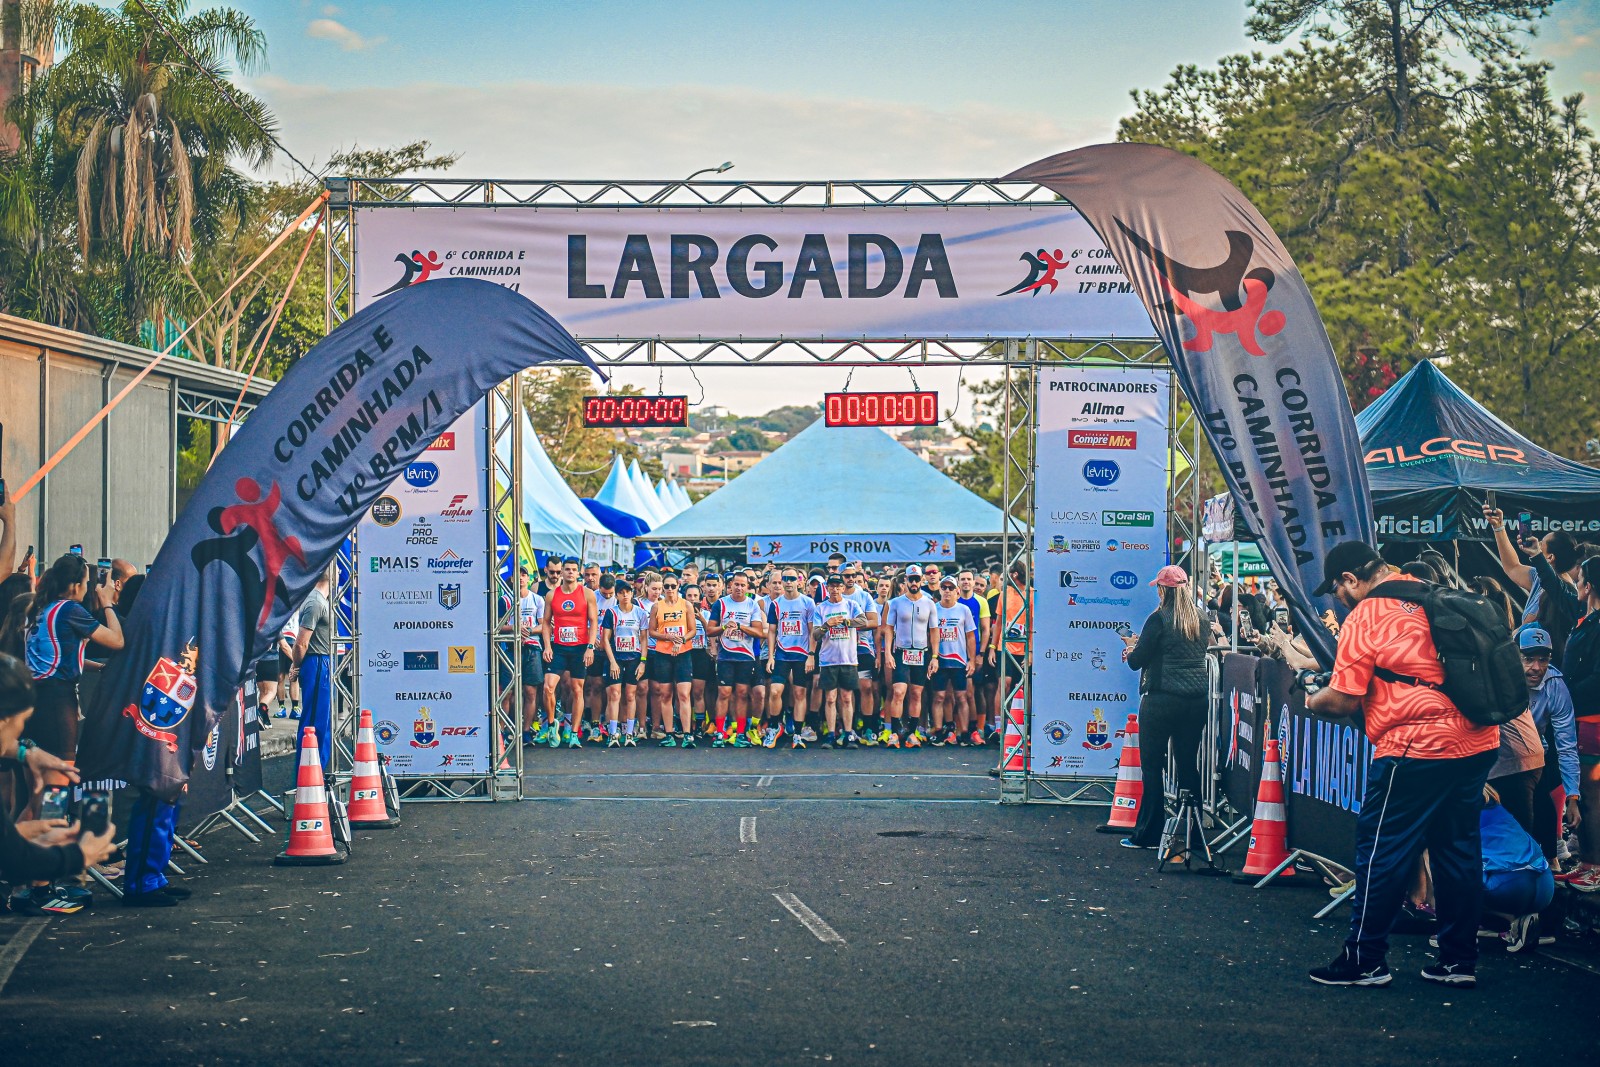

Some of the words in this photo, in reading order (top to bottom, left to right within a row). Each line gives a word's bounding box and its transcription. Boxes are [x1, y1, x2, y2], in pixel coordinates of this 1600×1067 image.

[462, 250, 514, 260] CORRIDA
[518, 250, 526, 260] E
[1088, 248, 1114, 258] COR
[449, 266, 521, 276] CAMINHADA
[568, 234, 958, 298] LARGADA
[274, 348, 374, 462] CORRIDA
[372, 324, 394, 352] E
[1050, 381, 1158, 394] PATROCINADORES
[586, 398, 682, 422] 00:00:00
[828, 394, 934, 422] 00:00:00
[1081, 402, 1124, 415] Allma
[296, 345, 432, 501] CAMINHADA
[1073, 434, 1108, 446] Compre
[1108, 436, 1132, 447] Mix
[1276, 368, 1337, 510] CORRIDA
[1320, 520, 1346, 538] E
[1364, 438, 1528, 464] ALCER
[1400, 457, 1436, 468] EVENTOS
[1439, 453, 1488, 464] ESPORTIVOS
[1233, 374, 1314, 566] CAMINHADA
[1136, 512, 1150, 520] Sin
[810, 538, 839, 553] PÓS
[844, 541, 892, 553] PROVA
[1120, 542, 1150, 550] Tereos
[428, 558, 473, 569] Rioprefer
[1243, 562, 1260, 571] Para
[1113, 576, 1135, 584] iGUi
[381, 591, 432, 599] IGUATEMI
[393, 621, 453, 629] APOIADORES
[369, 659, 399, 668] bioage
[396, 691, 452, 701] REALIZAÇÃO
[1292, 714, 1311, 796] LA
